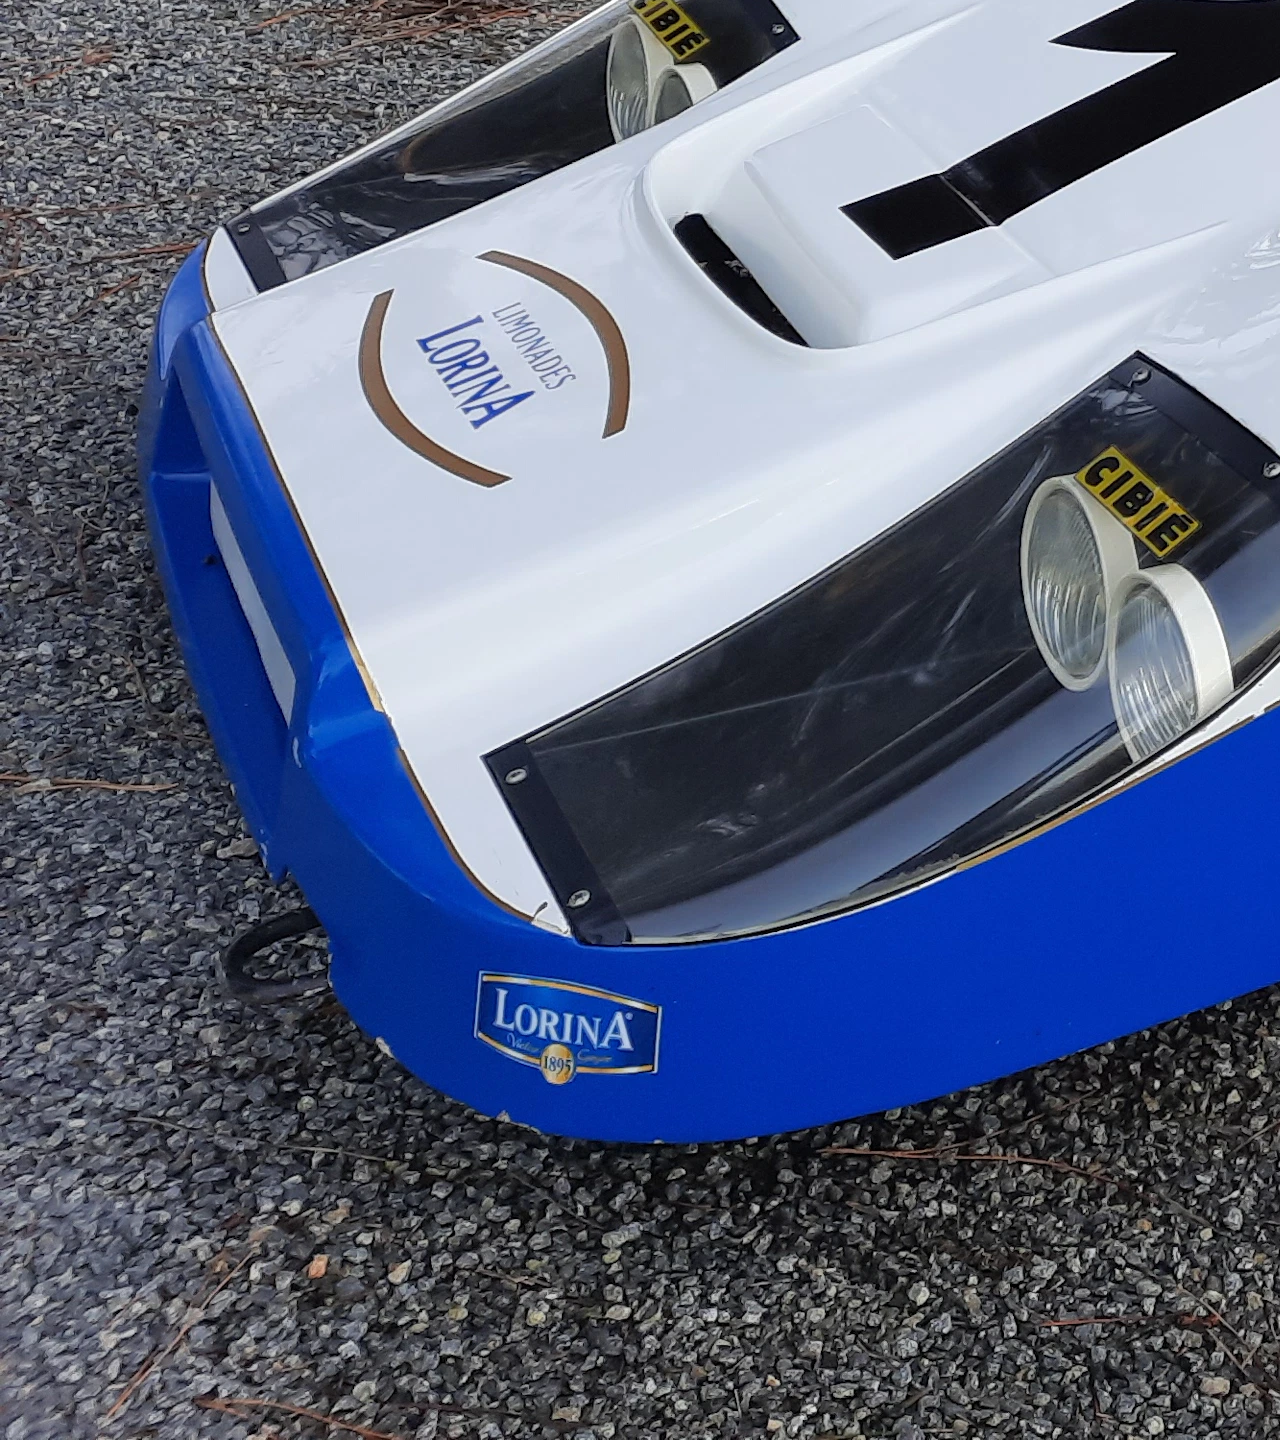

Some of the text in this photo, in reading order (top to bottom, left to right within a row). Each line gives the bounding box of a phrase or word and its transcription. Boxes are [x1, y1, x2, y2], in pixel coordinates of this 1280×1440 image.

[416, 315, 535, 430] LORINA
[492, 302, 577, 390] LIMONADES
[492, 988, 634, 1052] LORINA
[543, 1056, 573, 1076] 1895
